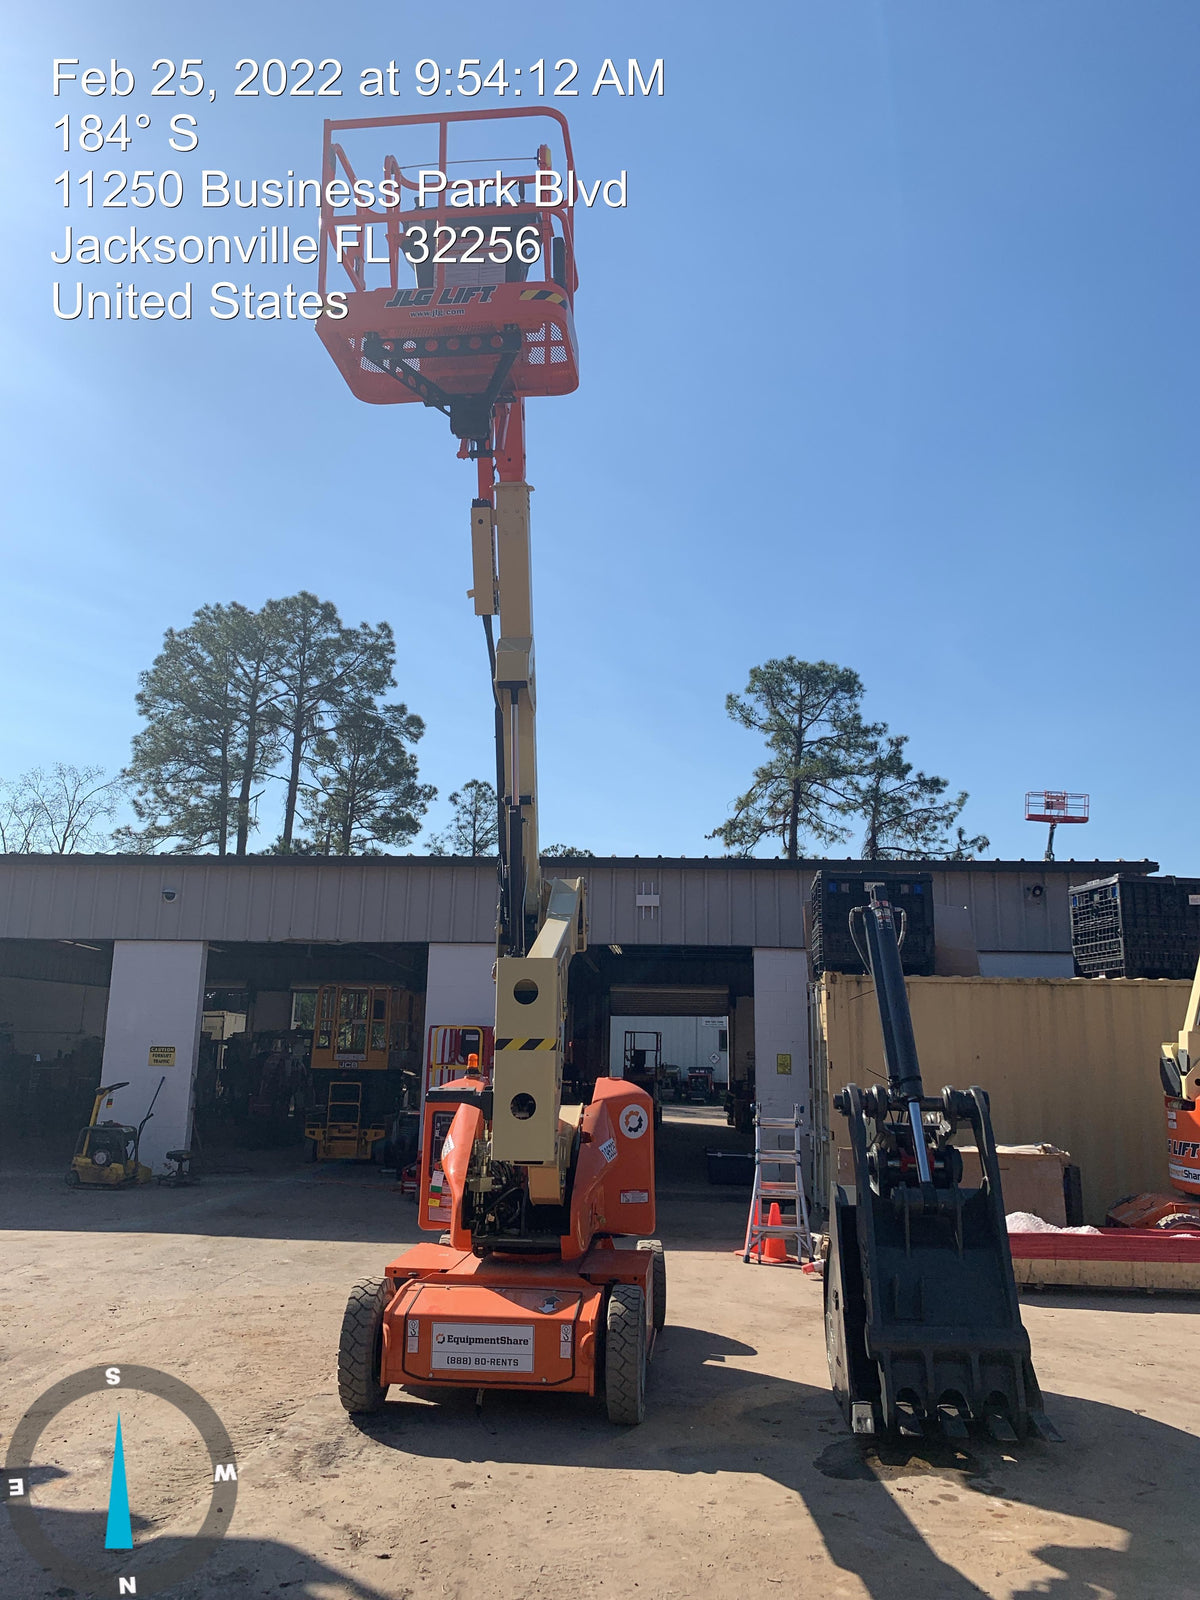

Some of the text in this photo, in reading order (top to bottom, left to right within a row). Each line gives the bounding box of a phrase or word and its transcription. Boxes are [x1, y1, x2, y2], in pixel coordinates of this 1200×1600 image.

[384, 285, 497, 308] JLG LIFT
[409, 308, 465, 318] www.jlg.com
[447, 1334, 530, 1346] EquipmentShare
[447, 1357, 519, 1367] (888) 80-RENTS
